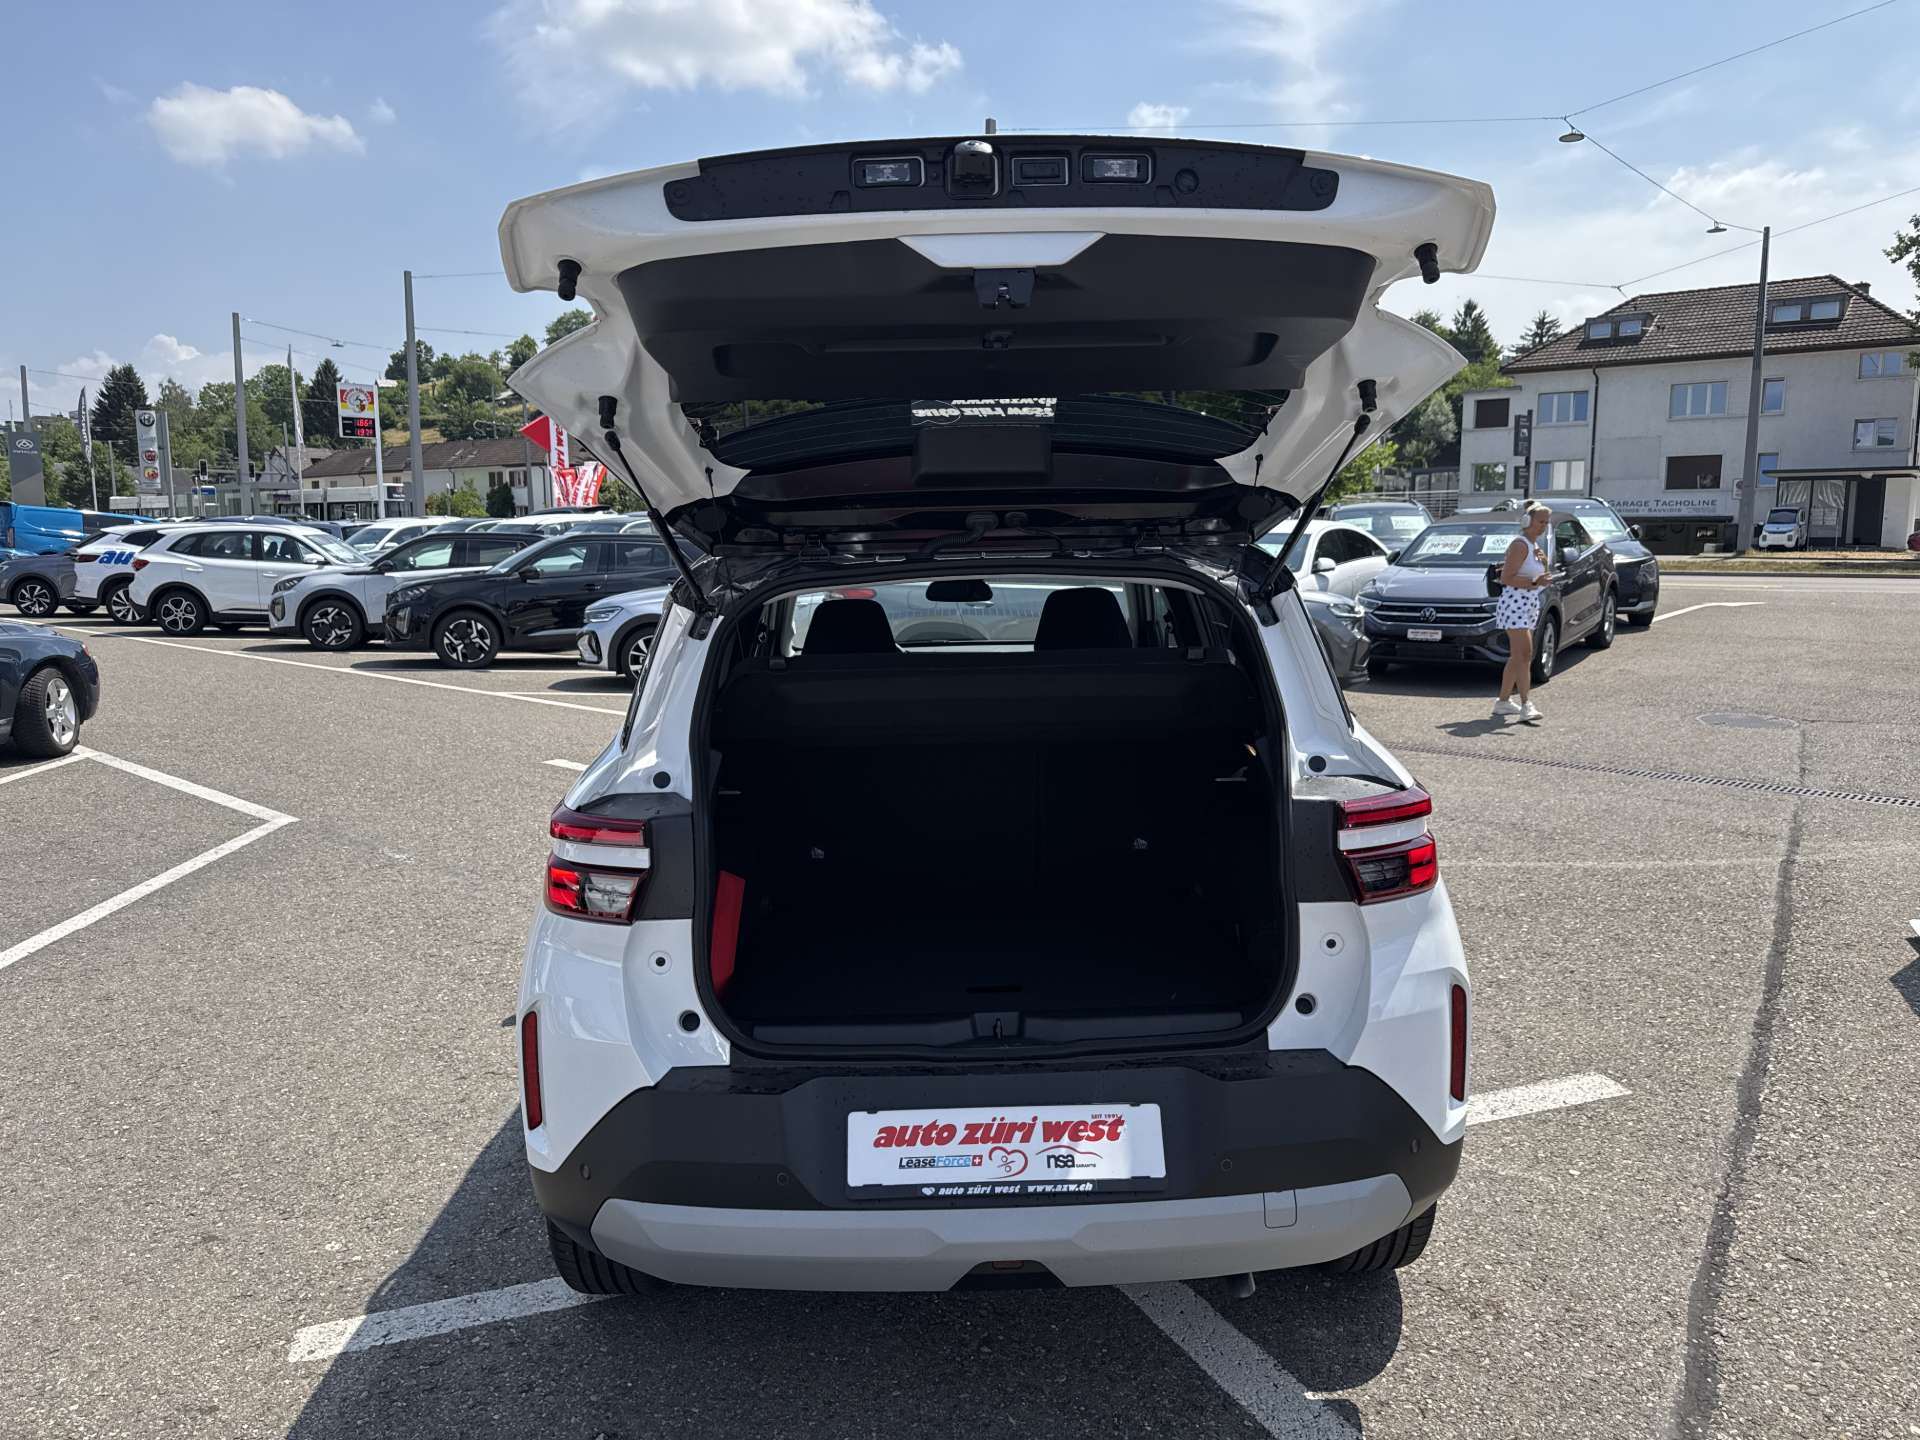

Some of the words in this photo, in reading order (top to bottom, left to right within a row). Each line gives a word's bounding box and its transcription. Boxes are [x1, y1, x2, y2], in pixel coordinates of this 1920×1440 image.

[1609, 499, 1650, 508] GARAGE
[1654, 499, 1718, 508] TACHOLINE
[873, 1119, 957, 1147] auto
[958, 1116, 1038, 1145] züri
[1042, 1115, 1125, 1142] west
[899, 1156, 971, 1169] LeaseForce
[1046, 1154, 1075, 1168] nsa
[938, 1187, 964, 1195] auto
[967, 1185, 992, 1195] züri
[994, 1184, 1021, 1194] west
